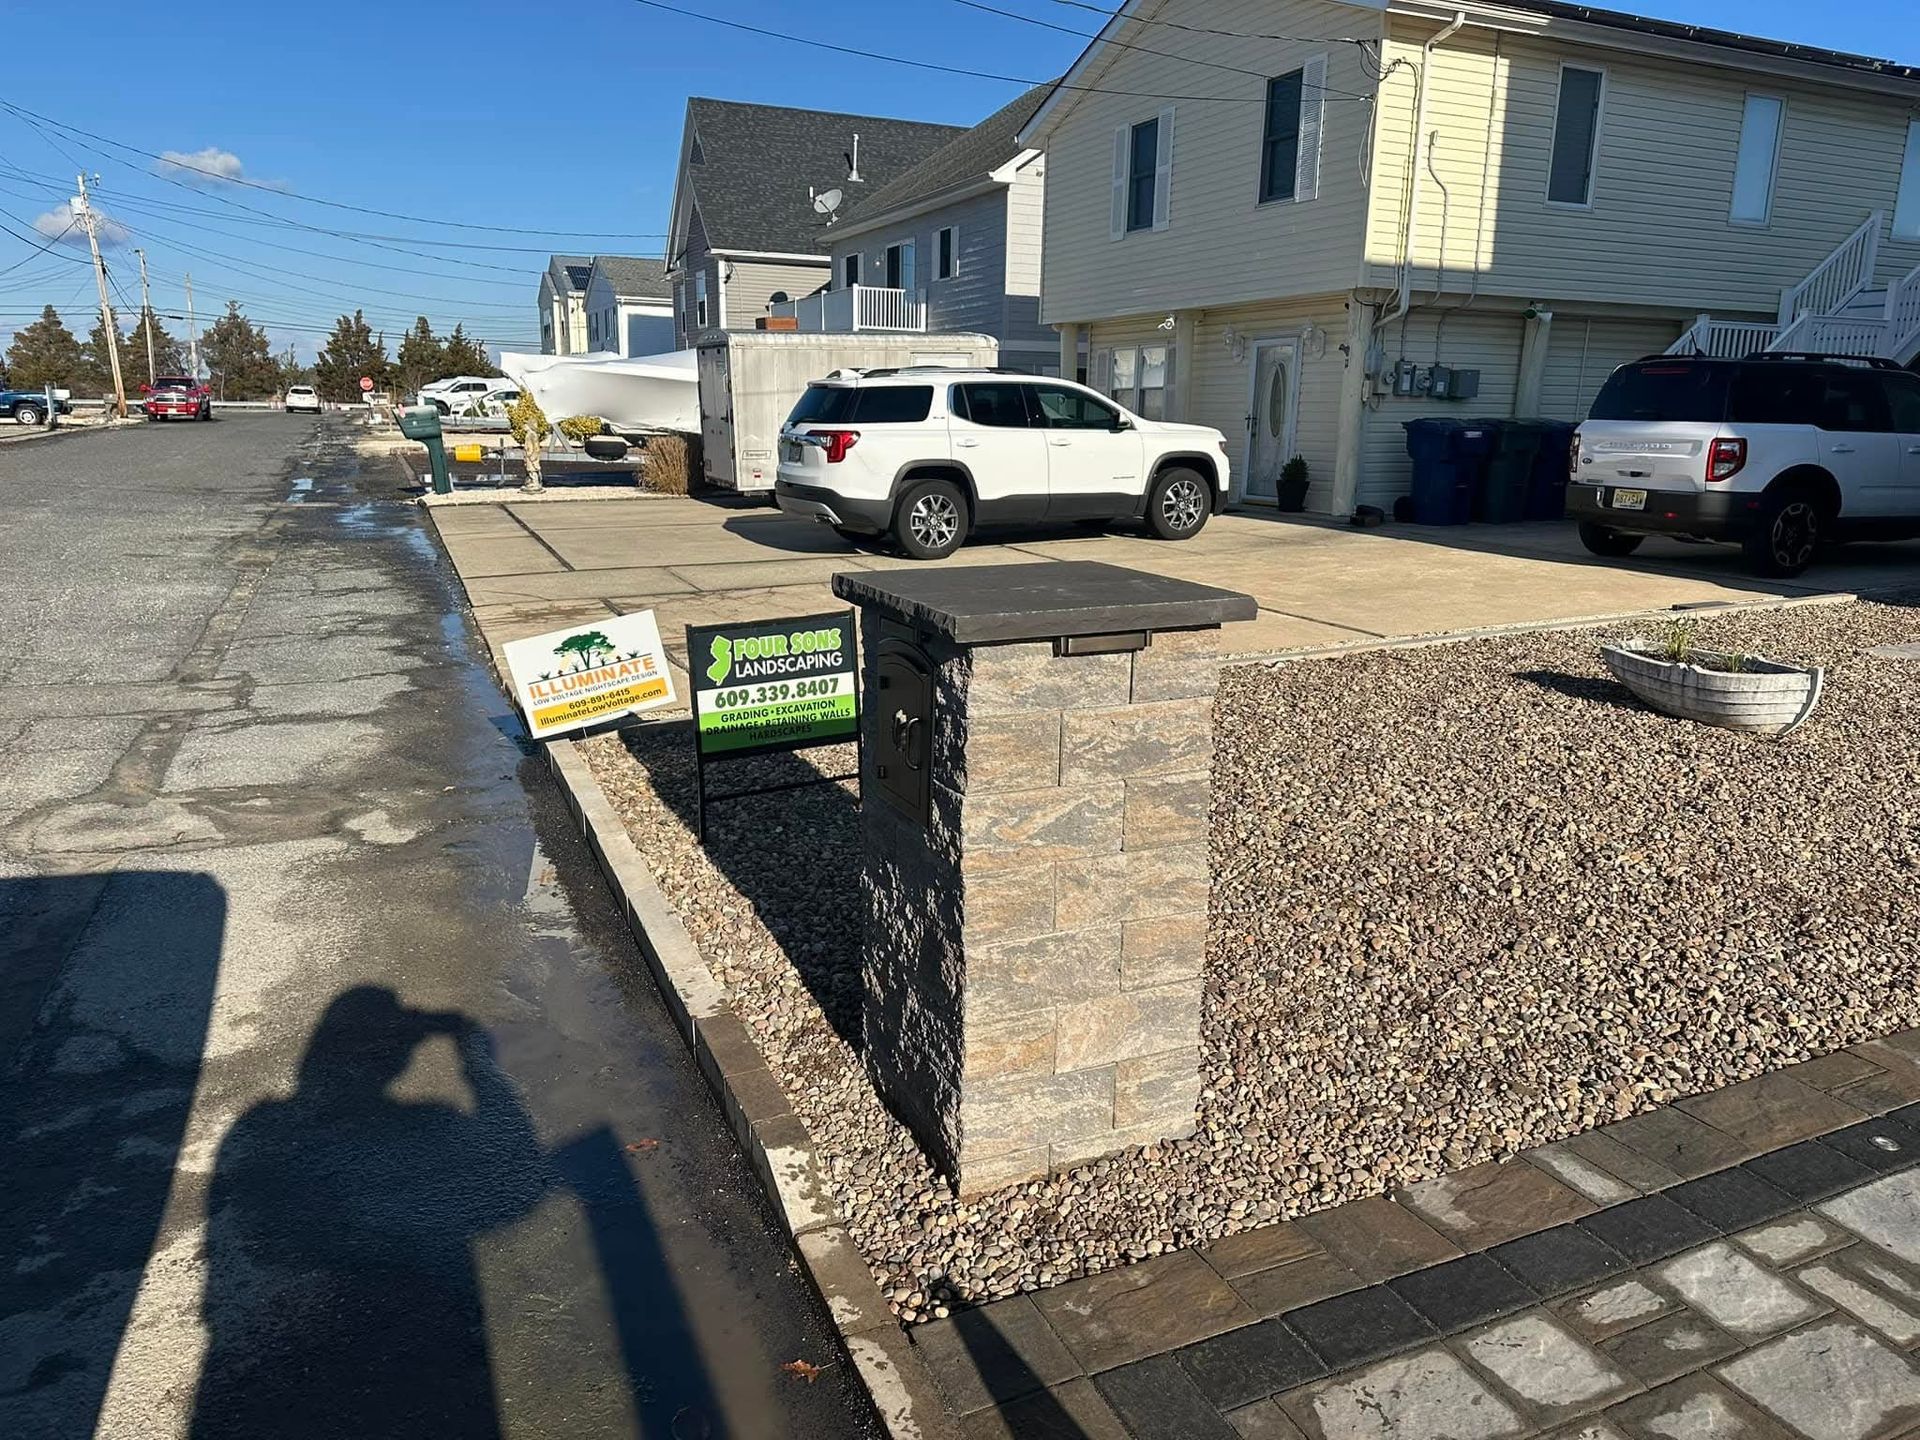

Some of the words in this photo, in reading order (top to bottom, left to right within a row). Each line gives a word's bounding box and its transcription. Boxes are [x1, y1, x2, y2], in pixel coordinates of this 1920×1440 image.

[733, 635, 789, 661] FOUR
[790, 628, 842, 655] SONS
[528, 656, 656, 699] ILLUMINATE
[735, 651, 843, 678] LANDSCAPING
[533, 697, 550, 706] LOW
[551, 690, 584, 702] VOLTAGE
[584, 677, 630, 693] NIGHTSCAPE
[631, 670, 658, 682] DESIGN
[569, 688, 630, 710] 609-891-6415
[715, 677, 839, 709] 609.339.8407
[540, 687, 662, 726] IlluminateLowVoltage.com
[705, 721, 761, 736] DRAINAGE
[819, 707, 851, 720] WALLS
[721, 708, 769, 723] GRADING
[775, 699, 836, 715] EXCAVATION
